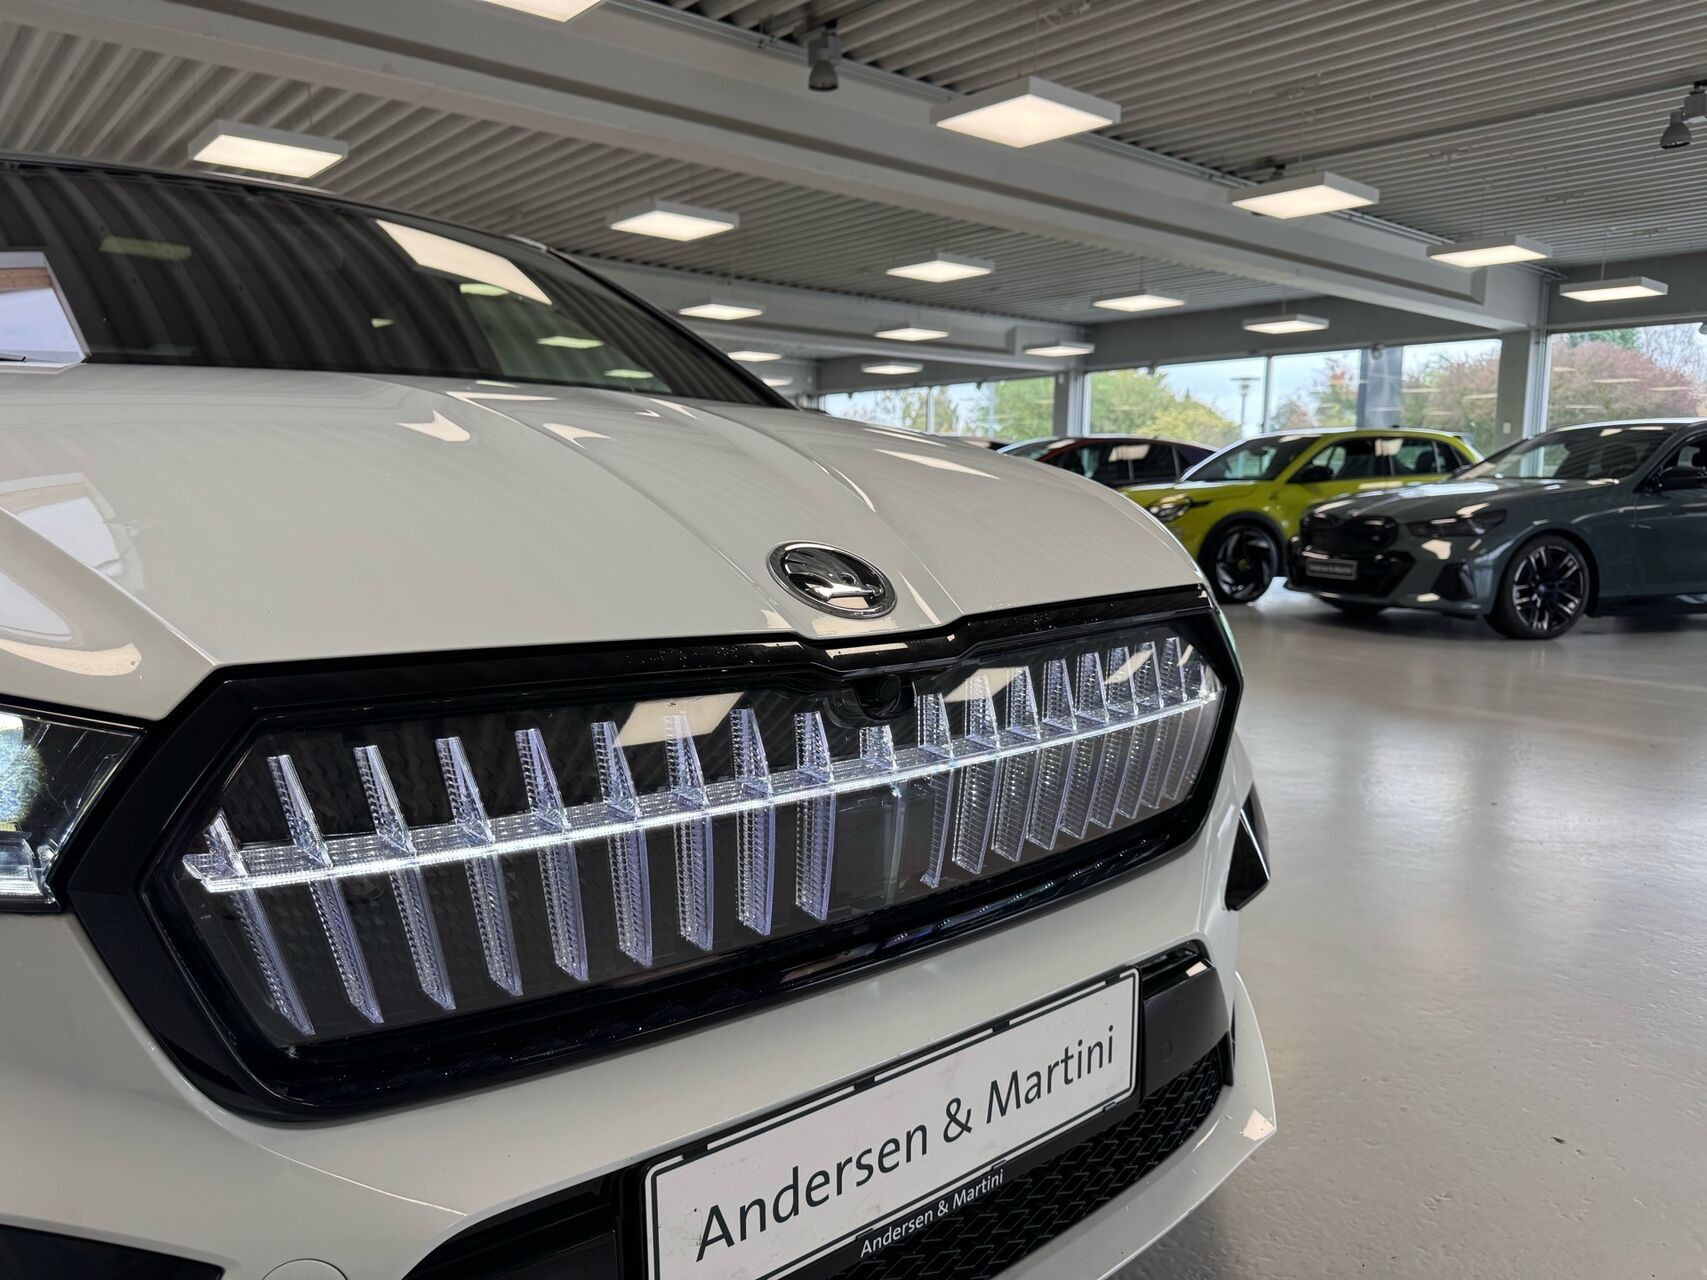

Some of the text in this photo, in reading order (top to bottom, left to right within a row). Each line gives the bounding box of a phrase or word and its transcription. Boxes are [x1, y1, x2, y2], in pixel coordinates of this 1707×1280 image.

[695, 1025, 1114, 1262] Andersen & Martini
[860, 1170, 1004, 1258] Andersen & Martini
